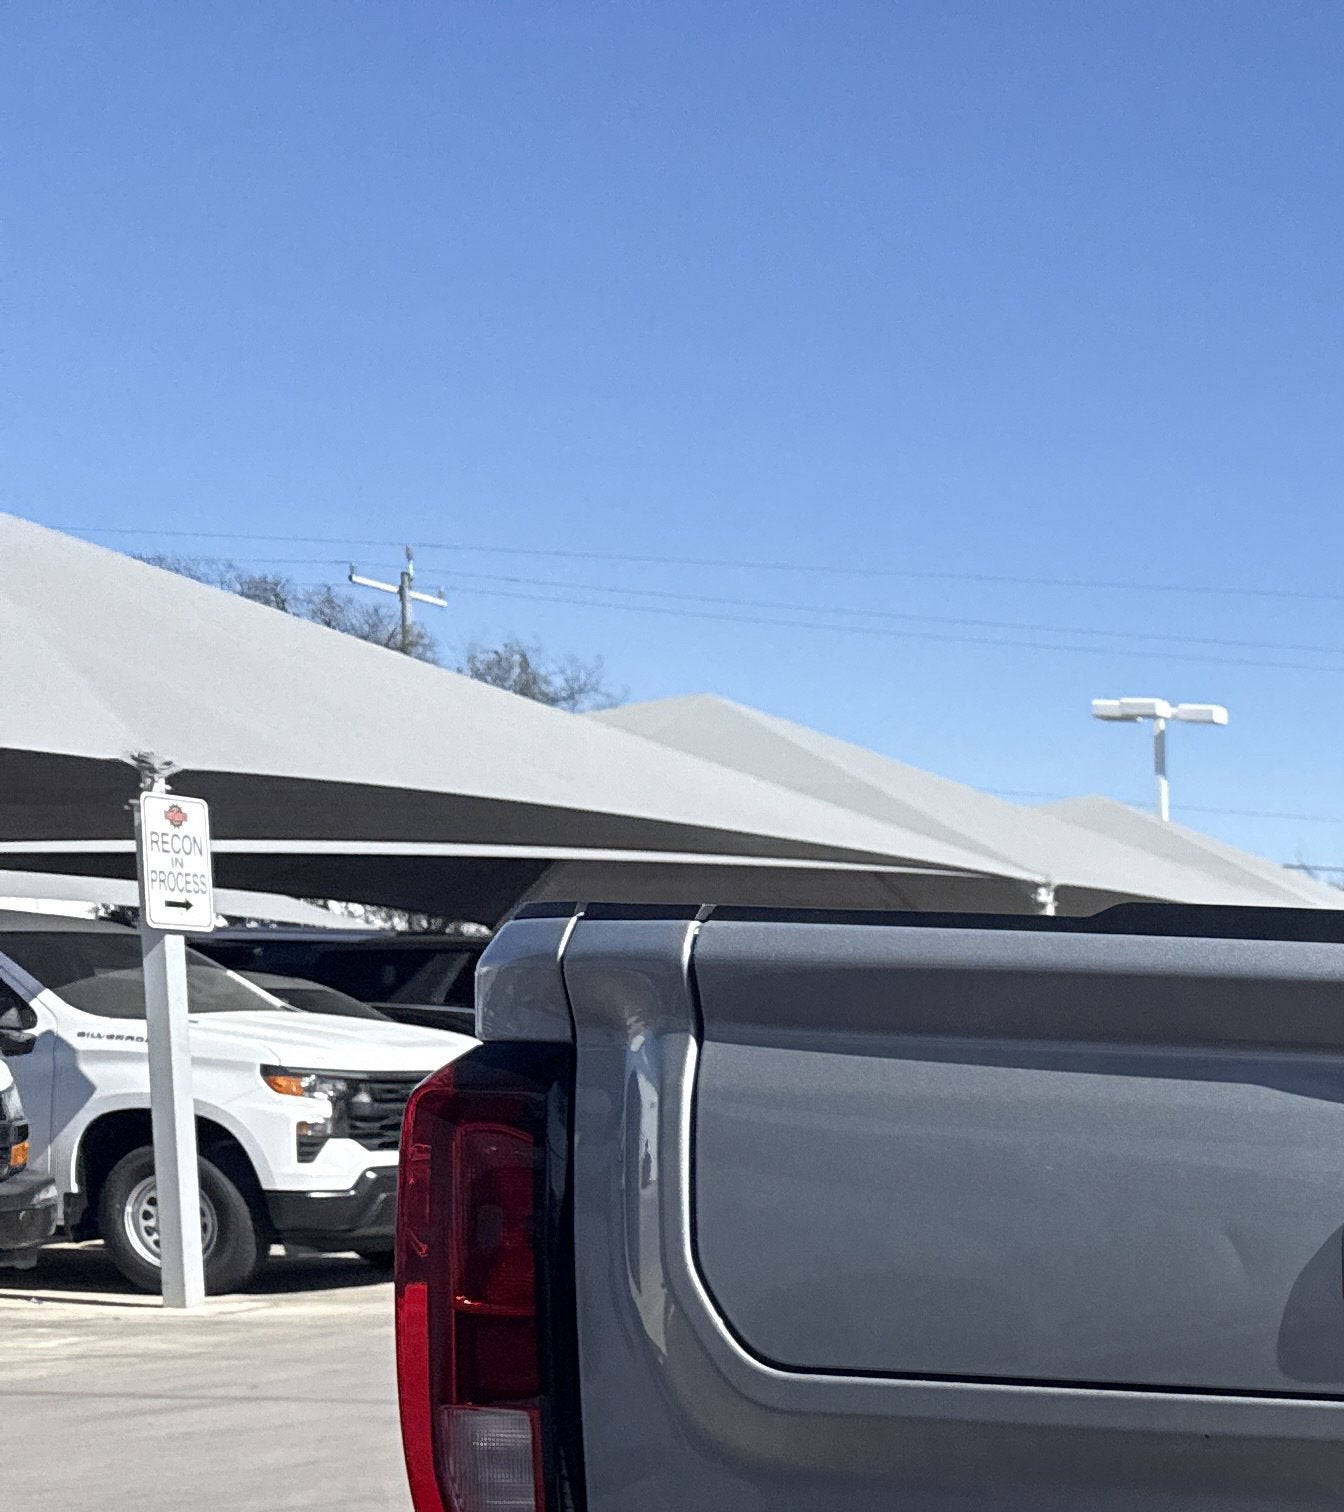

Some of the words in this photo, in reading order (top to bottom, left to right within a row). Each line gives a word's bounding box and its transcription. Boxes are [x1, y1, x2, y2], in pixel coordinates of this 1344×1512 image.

[150, 831, 203, 857] RECON
[171, 857, 184, 869] IN
[150, 869, 207, 895] PROCESS
[77, 1031, 149, 1043] SILVERAD
